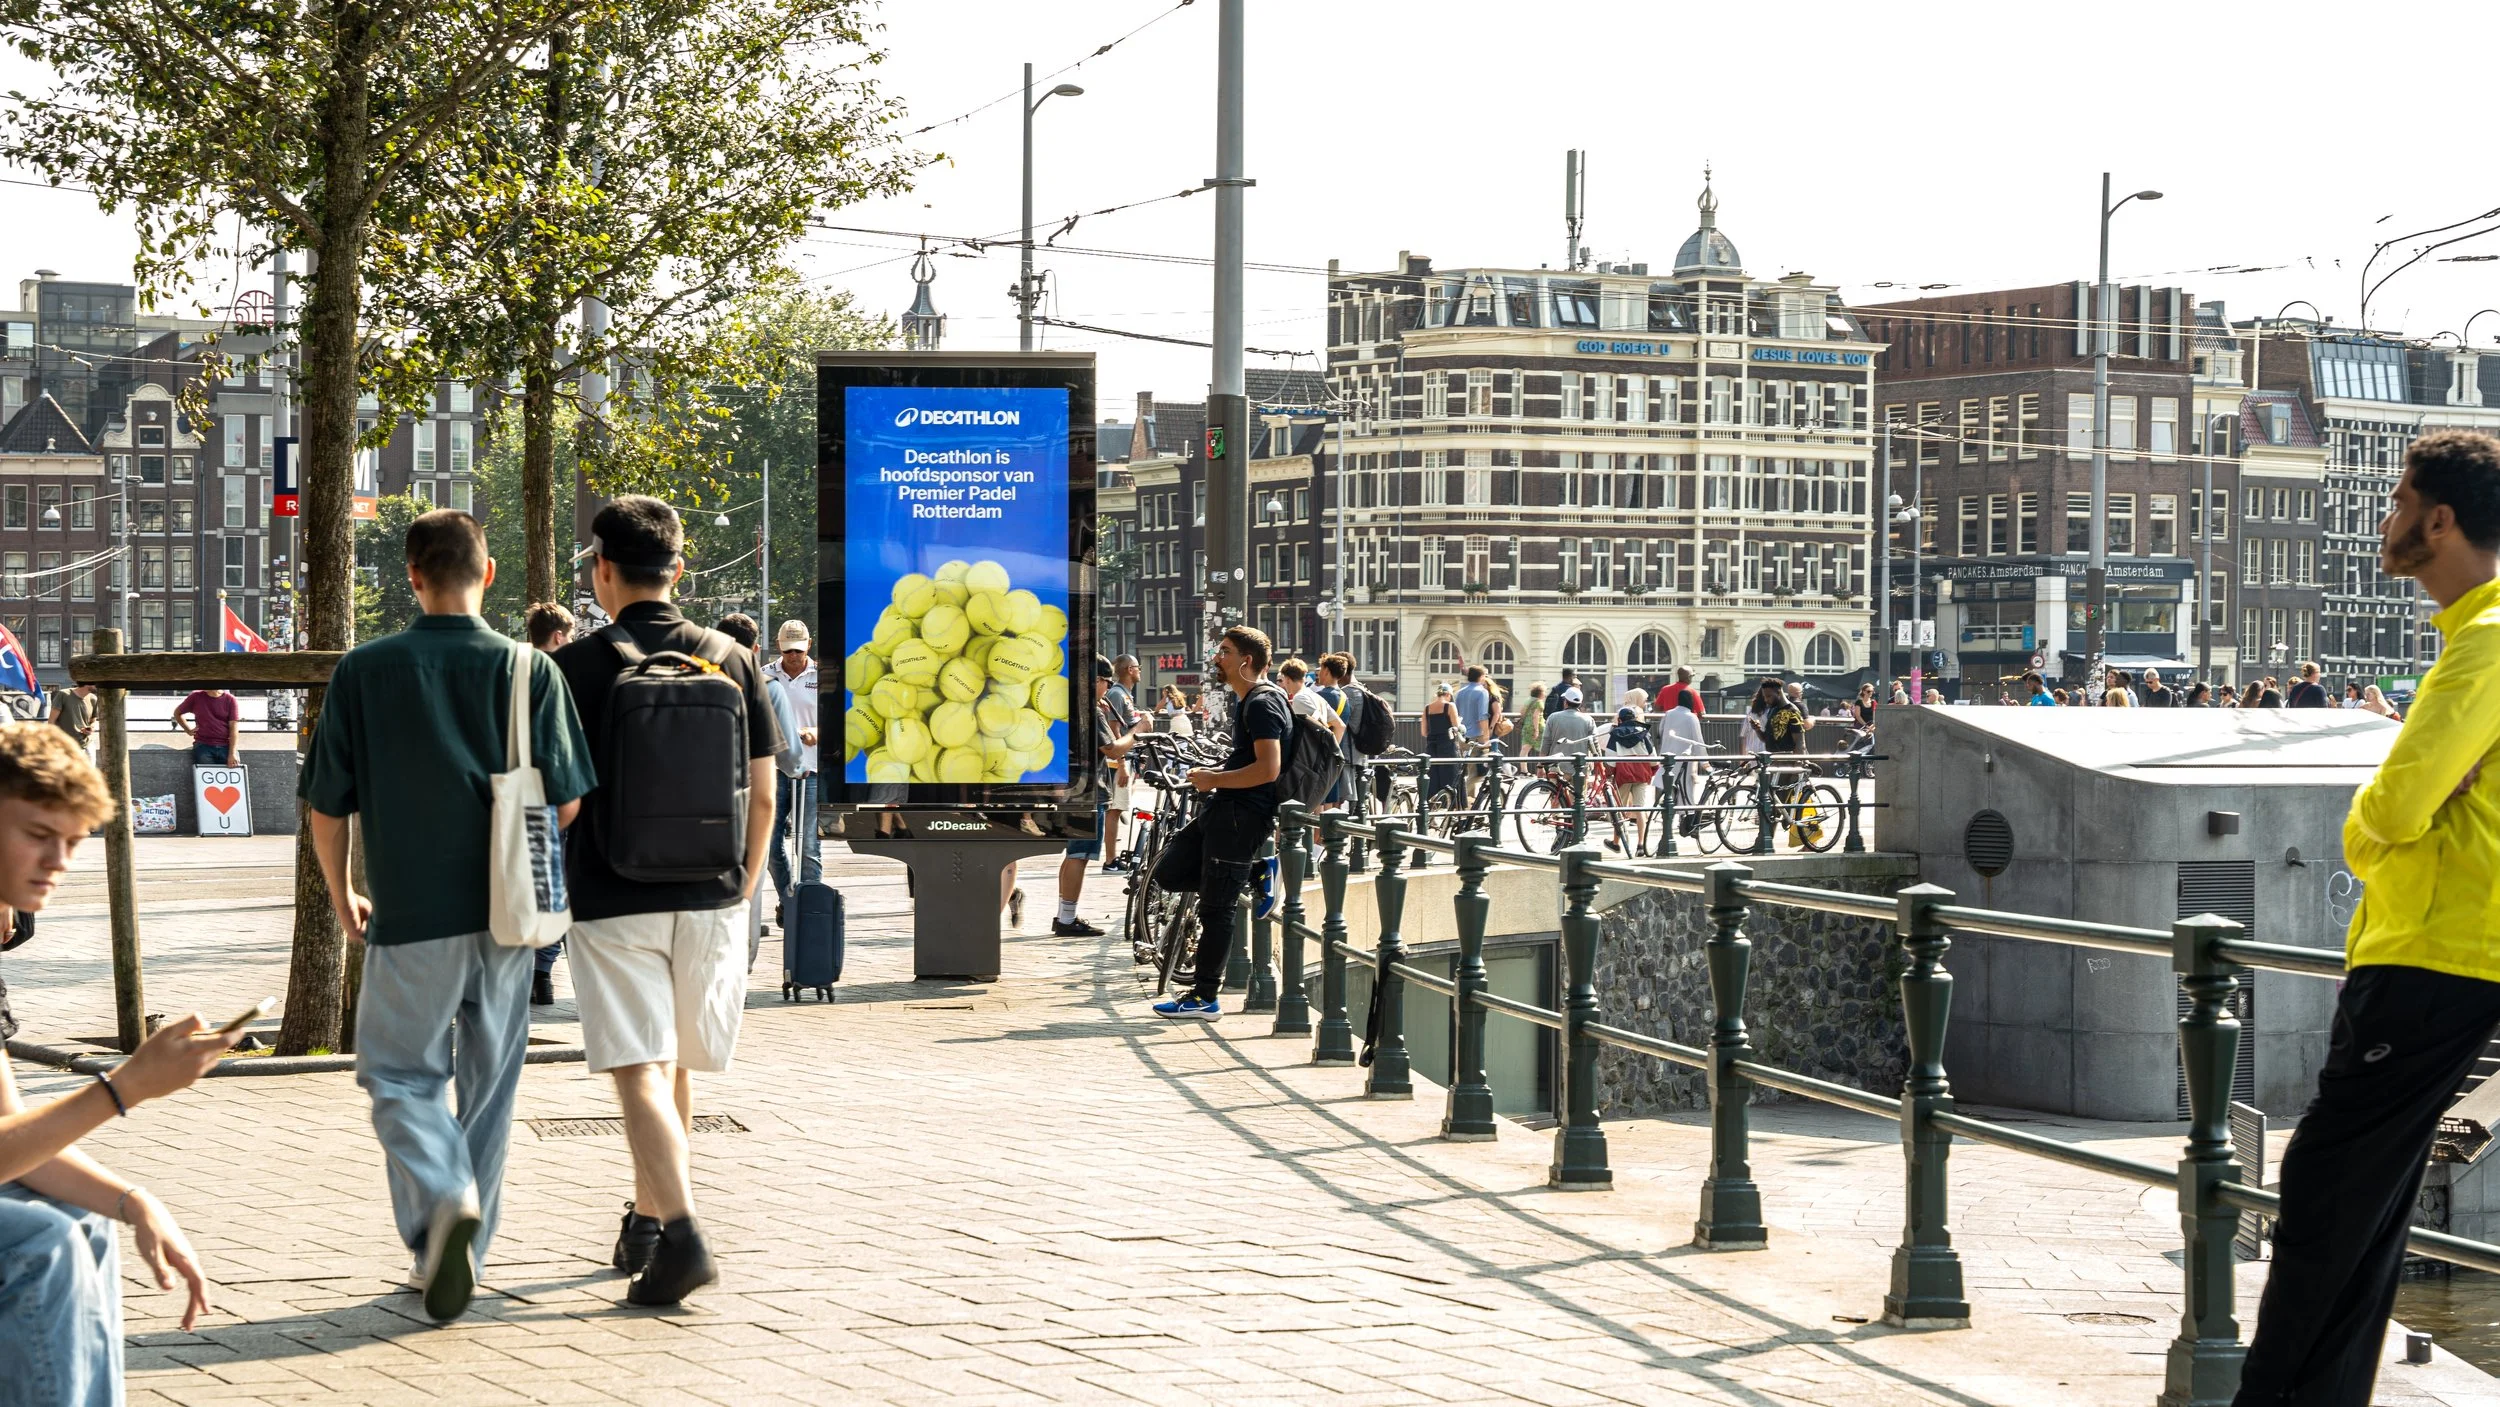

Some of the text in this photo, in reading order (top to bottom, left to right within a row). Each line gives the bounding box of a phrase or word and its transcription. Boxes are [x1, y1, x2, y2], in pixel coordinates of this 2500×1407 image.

[1577, 341, 1670, 355] GOD ROEPT U
[1753, 348, 1869, 365] JESUS LOVES YOU
[920, 411, 1020, 425] DECATHLON
[904, 449, 1011, 464] Decathlon is
[880, 467, 1034, 485] hoofdsponsor van
[898, 486, 1016, 500] Premier Padel
[912, 503, 1002, 518] Rotterdam
[202, 771, 241, 785] GOD
[145, 808, 170, 816] ACTION
[219, 816, 231, 829] U
[927, 821, 987, 831] JCDecaux
